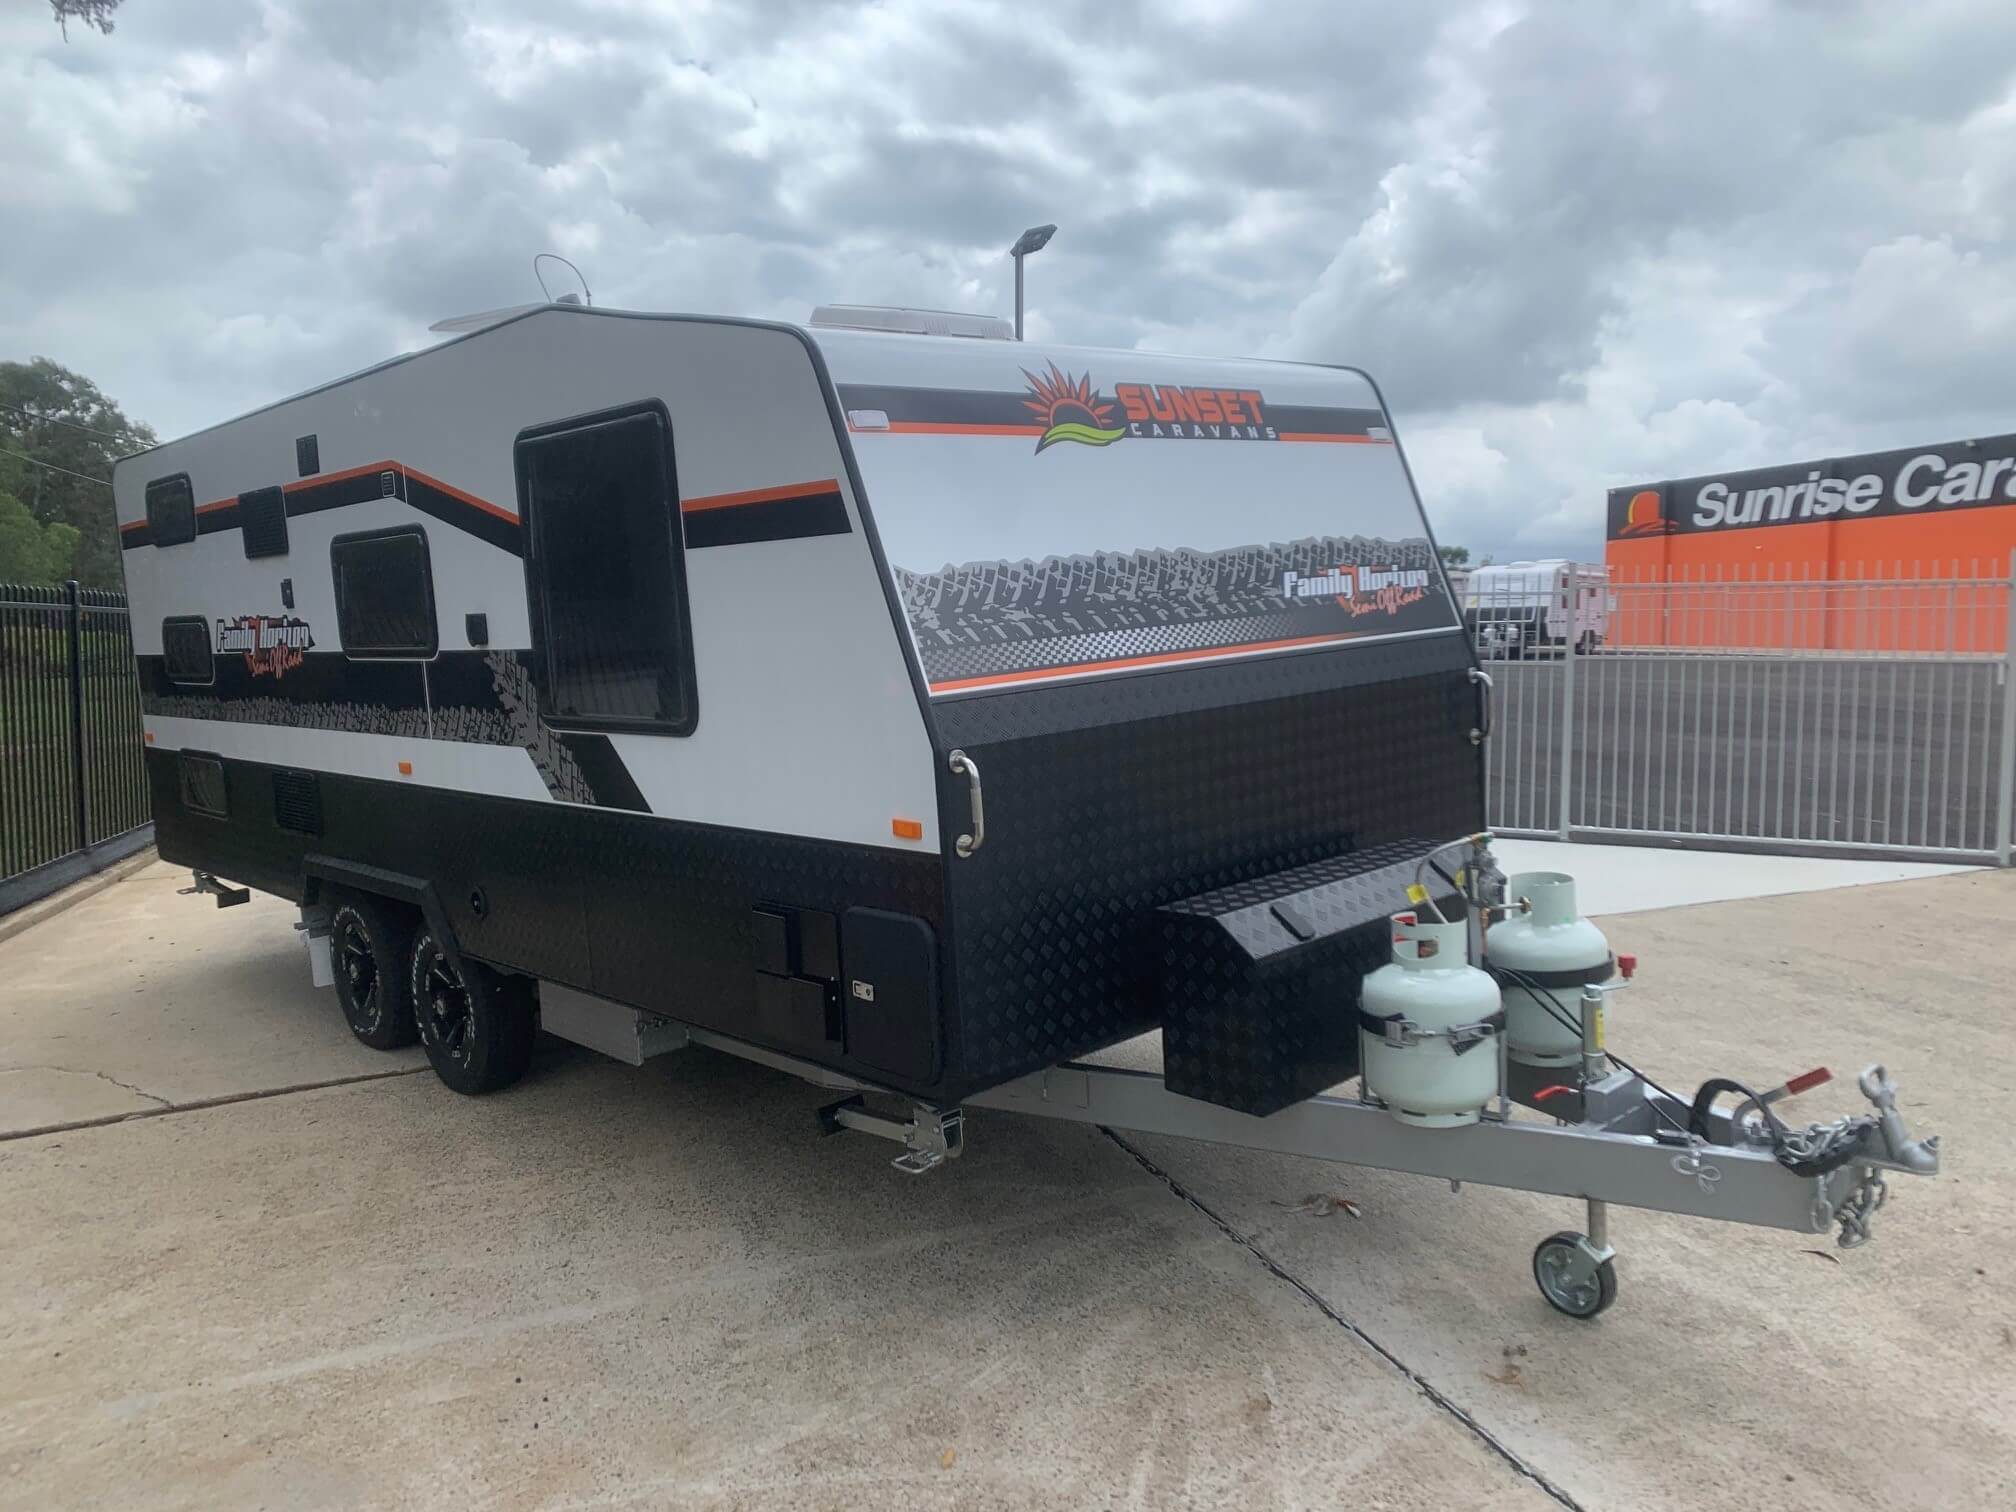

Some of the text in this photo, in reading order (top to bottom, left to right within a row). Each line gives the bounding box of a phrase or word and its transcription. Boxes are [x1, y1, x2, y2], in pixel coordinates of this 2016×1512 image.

[1115, 383, 1264, 424] SUNSET
[1130, 422, 1277, 439] CARAVANS
[1693, 454, 2016, 527] Sunrise Car
[1284, 568, 1353, 599] Family
[217, 619, 256, 655] Family
